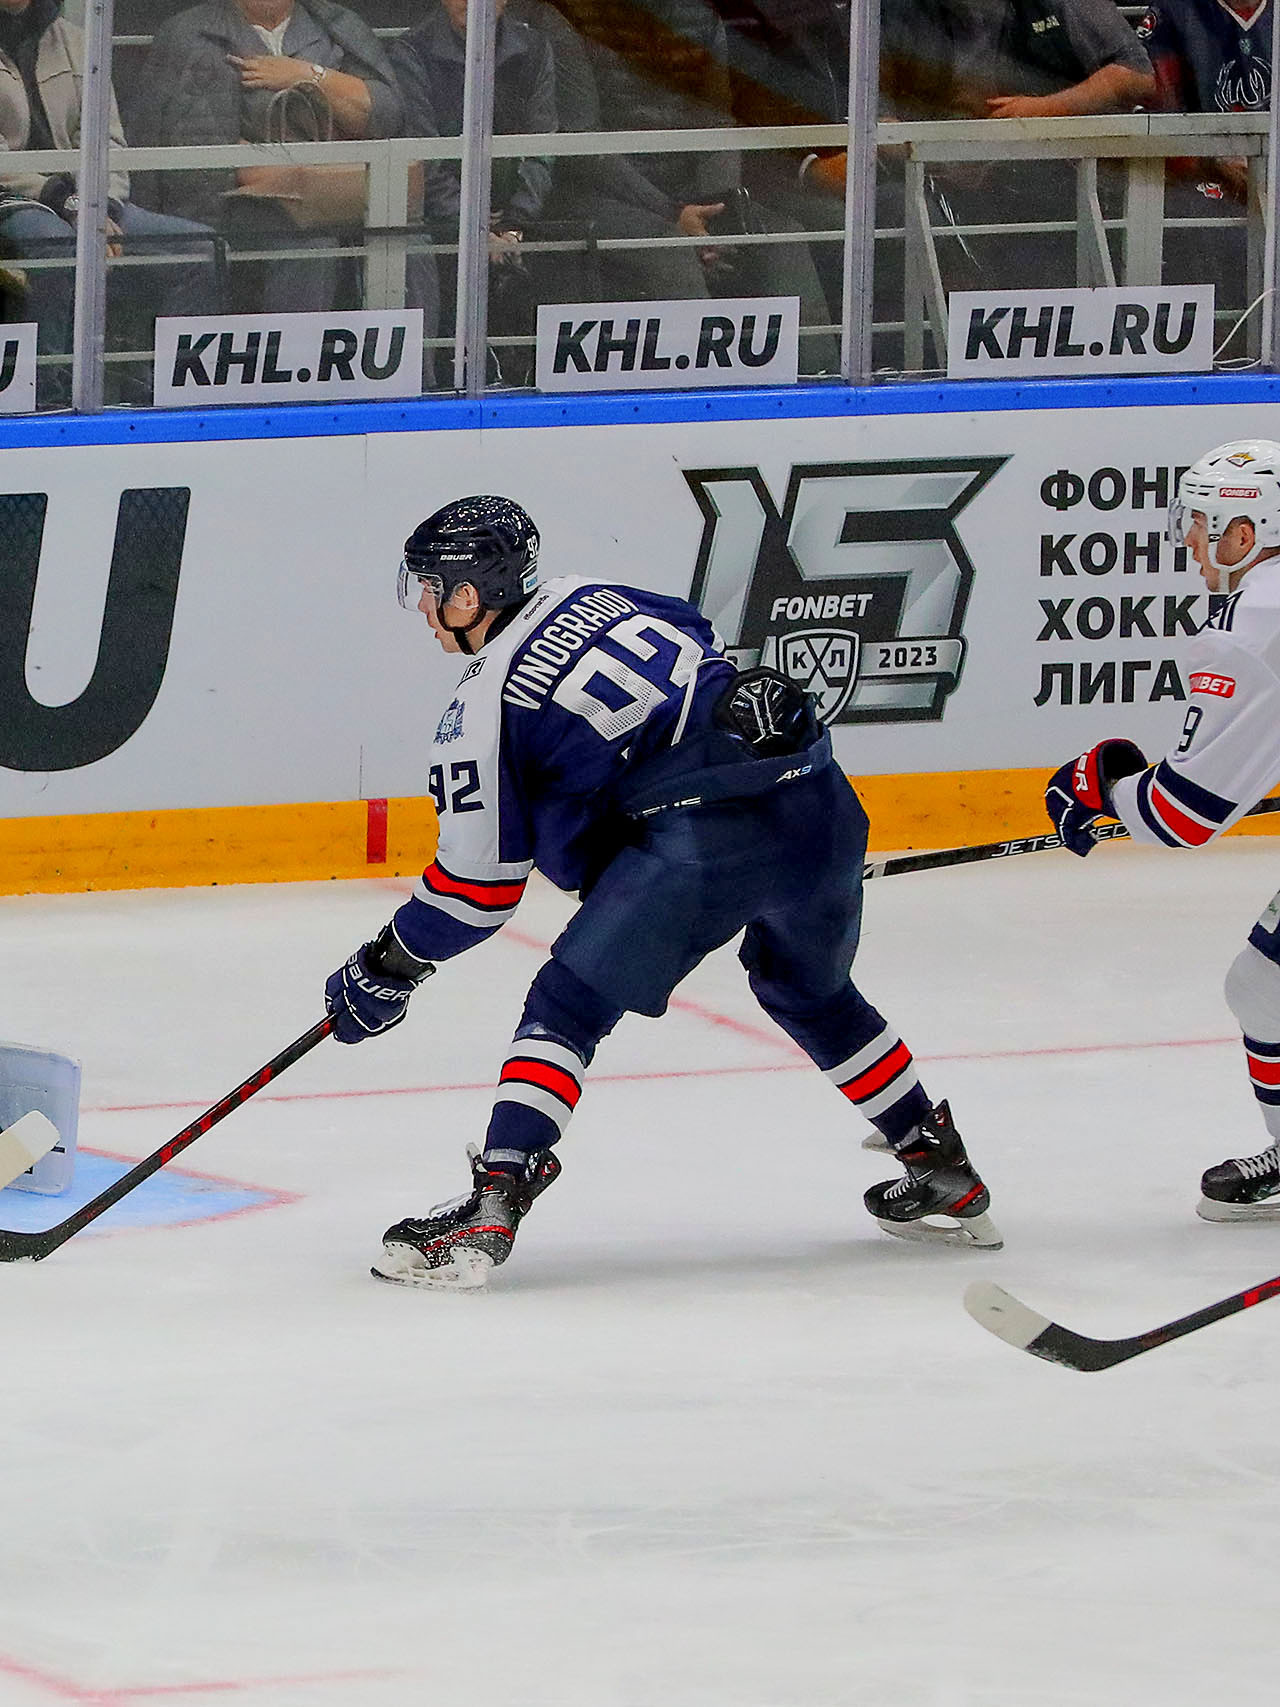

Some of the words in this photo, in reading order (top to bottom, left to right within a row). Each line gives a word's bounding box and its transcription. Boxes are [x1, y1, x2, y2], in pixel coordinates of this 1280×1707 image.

[552, 313, 783, 374] KHL.RU
[965, 302, 1198, 360] KHL.RU
[172, 327, 407, 387] KHL.RU
[1220, 488, 1257, 498] FONBET
[770, 593, 874, 621] FONBET
[878, 646, 938, 669] 2023
[1033, 659, 1187, 707] ЛИГА
[776, 766, 812, 782] AX9
[991, 824, 1130, 857] JETSED
[347, 952, 411, 1001] BAUER
